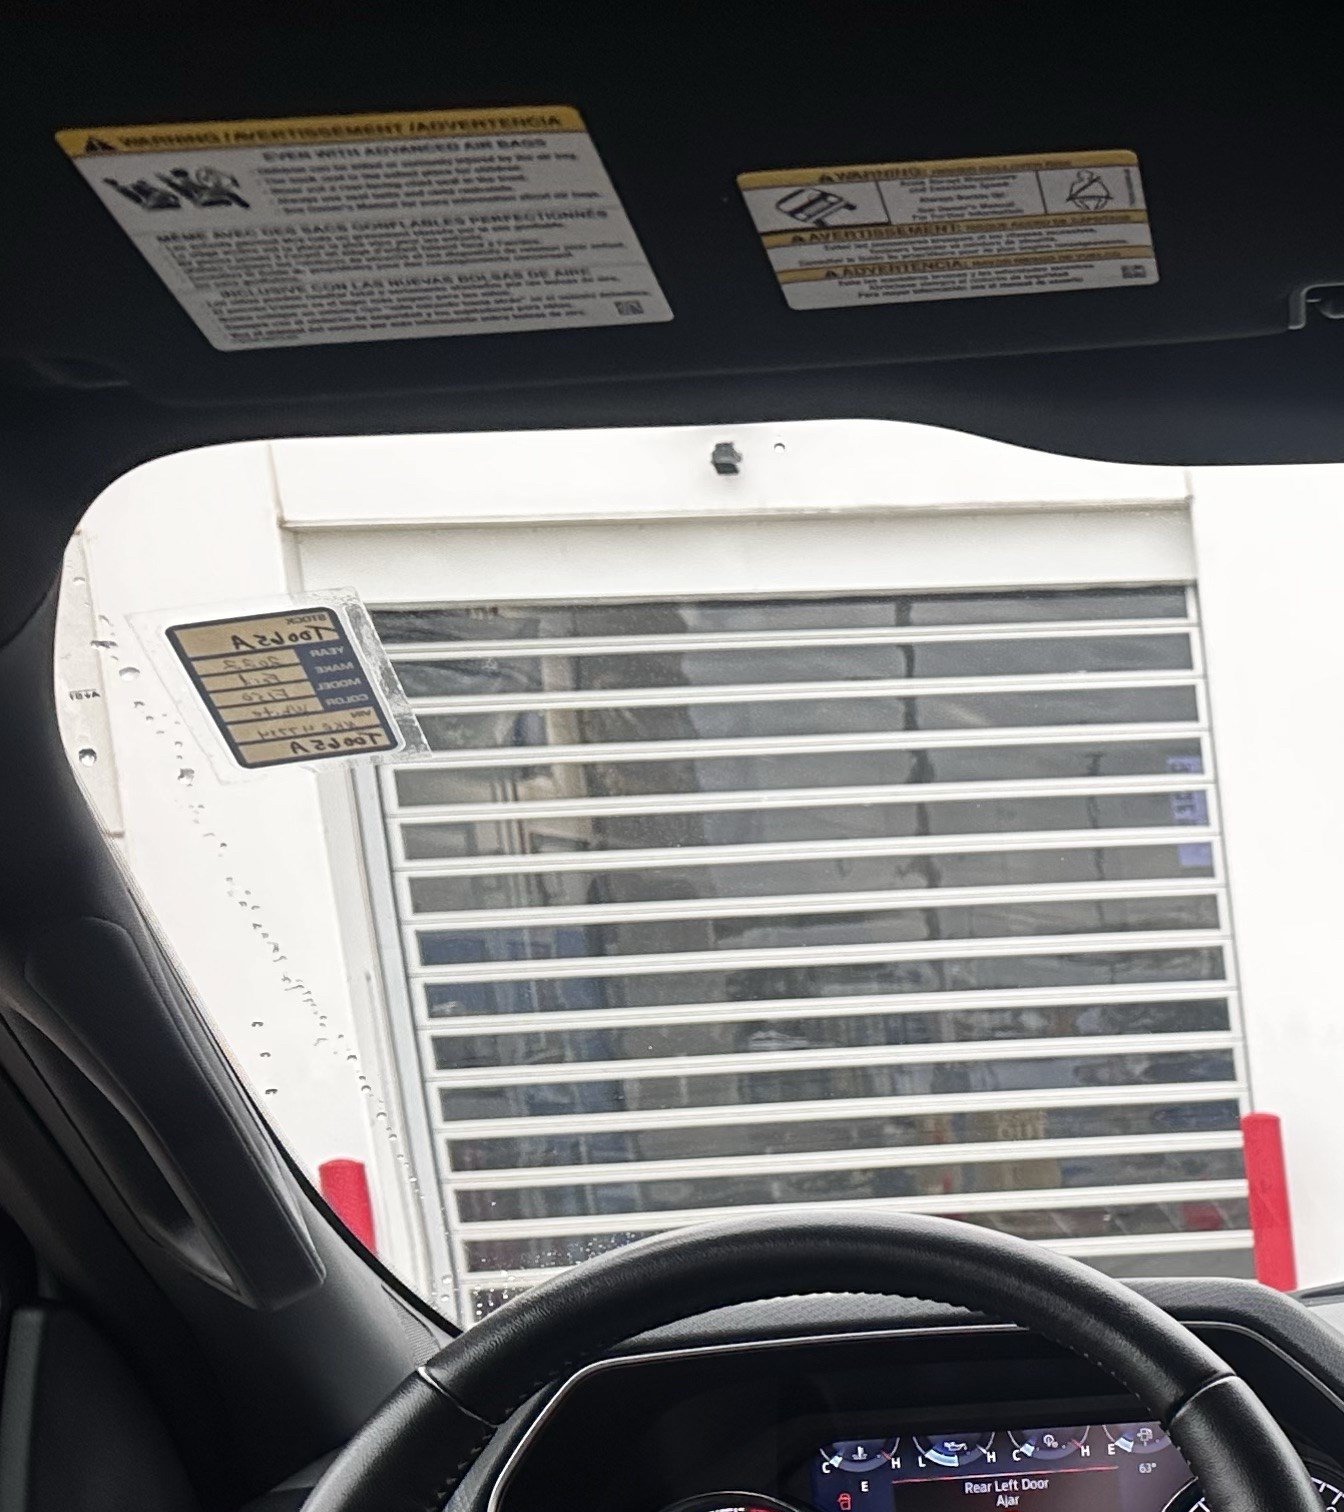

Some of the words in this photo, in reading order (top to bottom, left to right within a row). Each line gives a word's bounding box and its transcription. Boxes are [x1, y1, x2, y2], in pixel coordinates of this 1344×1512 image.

[1012, 1450, 1021, 1462] C
[1081, 1445, 1091, 1457] H
[891, 1458, 901, 1469] H
[918, 1457, 927, 1468] L
[986, 1452, 997, 1463] H
[822, 1462, 831, 1474] C
[860, 1481, 869, 1492] E
[964, 1482, 993, 1495] Rear
[994, 1480, 1019, 1493] Left
[1021, 1478, 1050, 1491] Door
[995, 1494, 1020, 1509] Ajar
